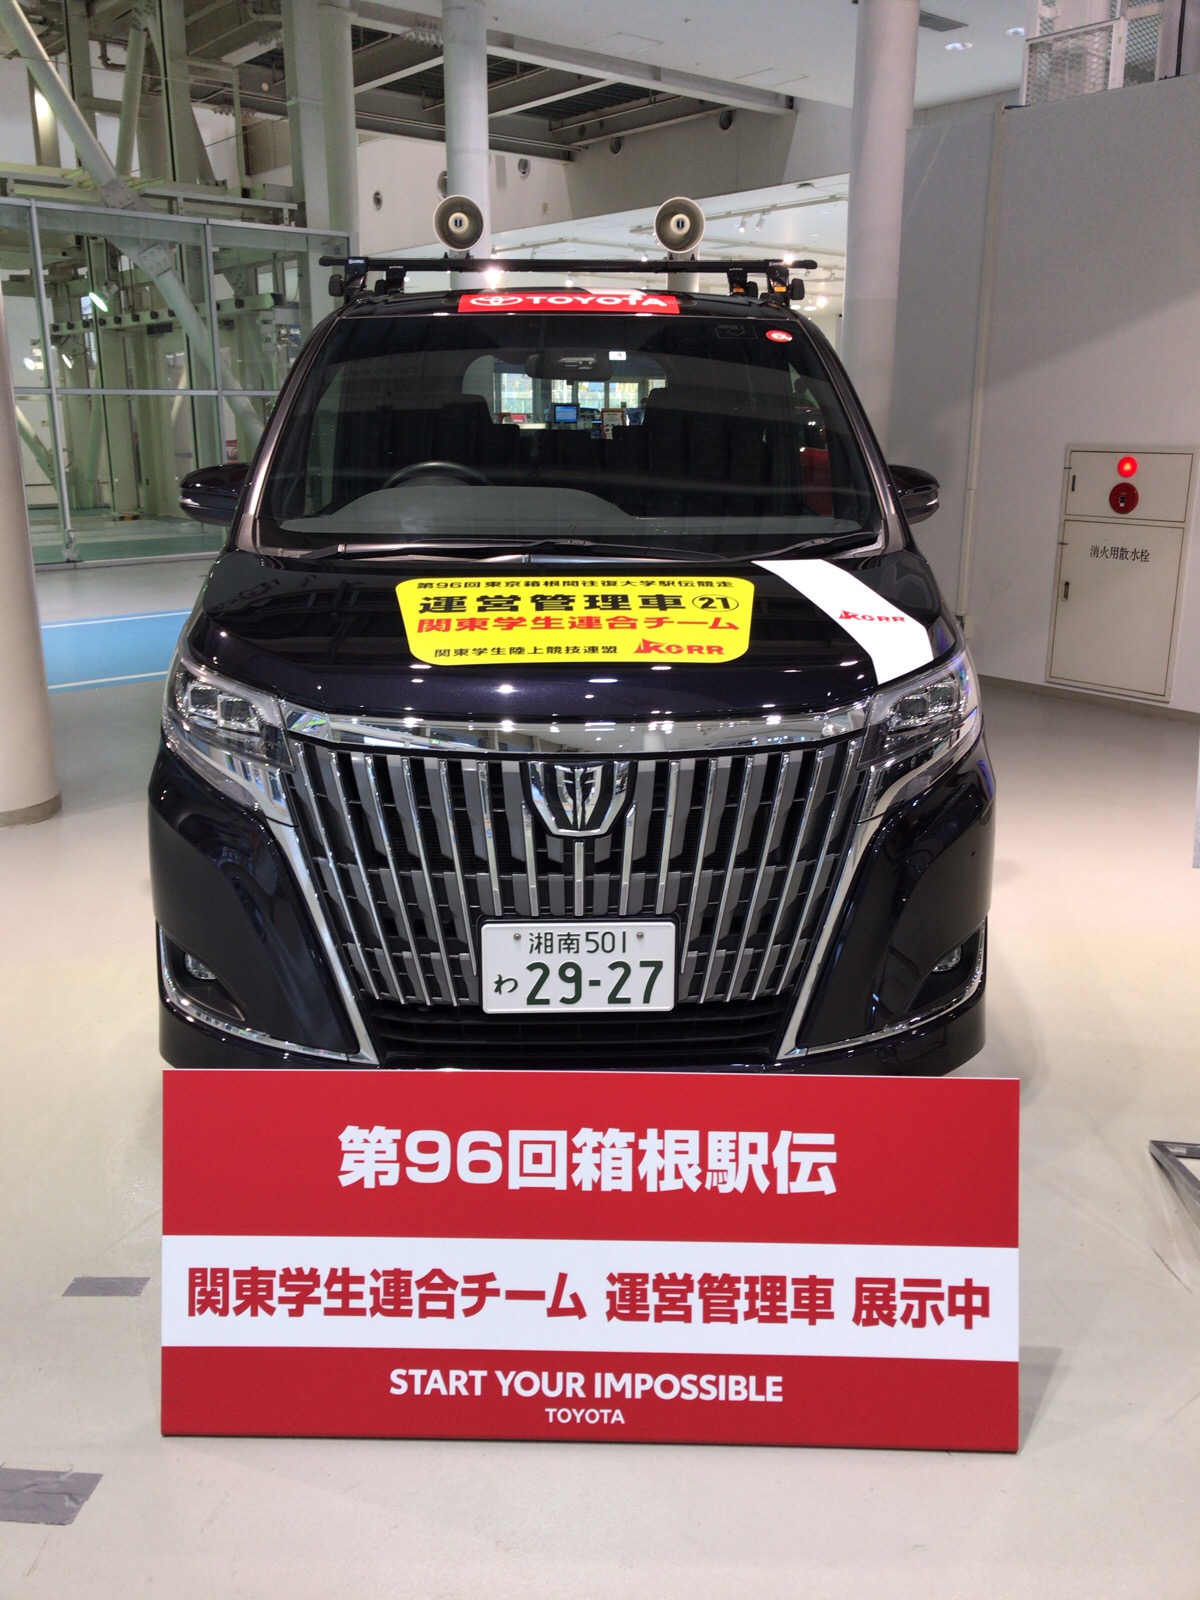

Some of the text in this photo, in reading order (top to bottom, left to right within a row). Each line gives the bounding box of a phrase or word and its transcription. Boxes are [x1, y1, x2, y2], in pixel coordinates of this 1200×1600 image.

[526, 295, 668, 307] TOYOTA
[1089, 545, 1150, 563] 消火用散水栓
[416, 615, 740, 633] 関東学生連合チーム
[434, 645, 618, 658] 関東学生陸上競技連盟
[493, 960, 664, 1006] わ 29-27
[337, 1124, 838, 1196] 第96回箱根駅伝
[187, 1266, 991, 1331] 関東学生連合チーム 運営管理車 展示中
[389, 1368, 784, 1403] START YOUR IMPOSSIBLE
[544, 1407, 626, 1425] TOYOTA
